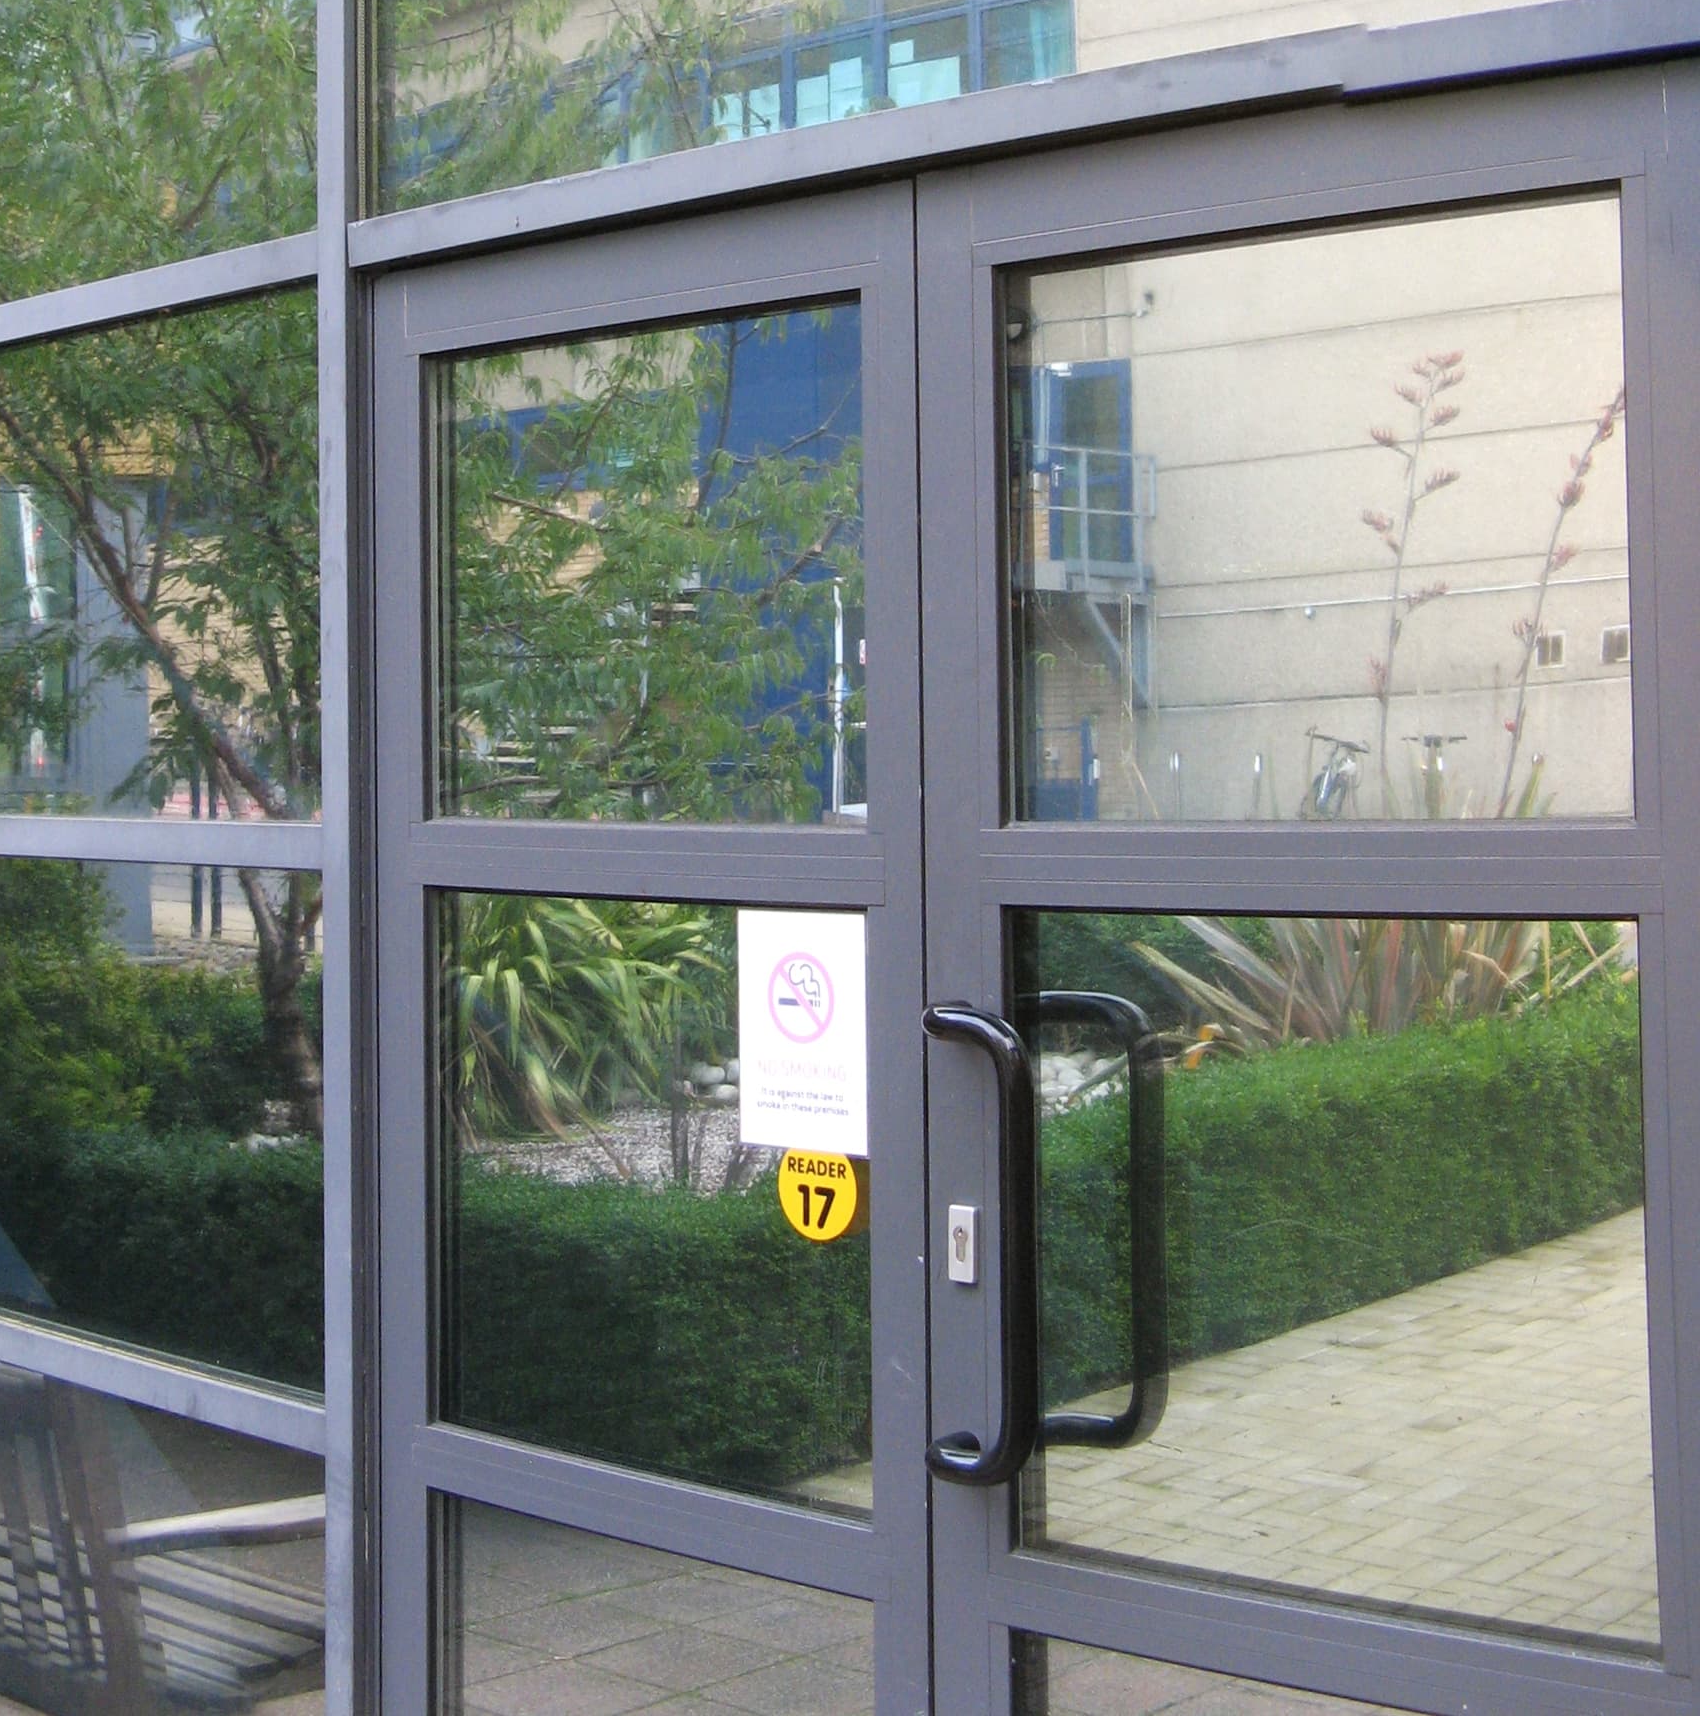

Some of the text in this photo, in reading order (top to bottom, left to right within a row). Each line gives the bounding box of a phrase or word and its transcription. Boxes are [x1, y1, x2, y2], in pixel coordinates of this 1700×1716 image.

[781, 1060, 847, 1083] SMOKING
[787, 1156, 847, 1180] READER
[798, 1183, 836, 1230] 17
